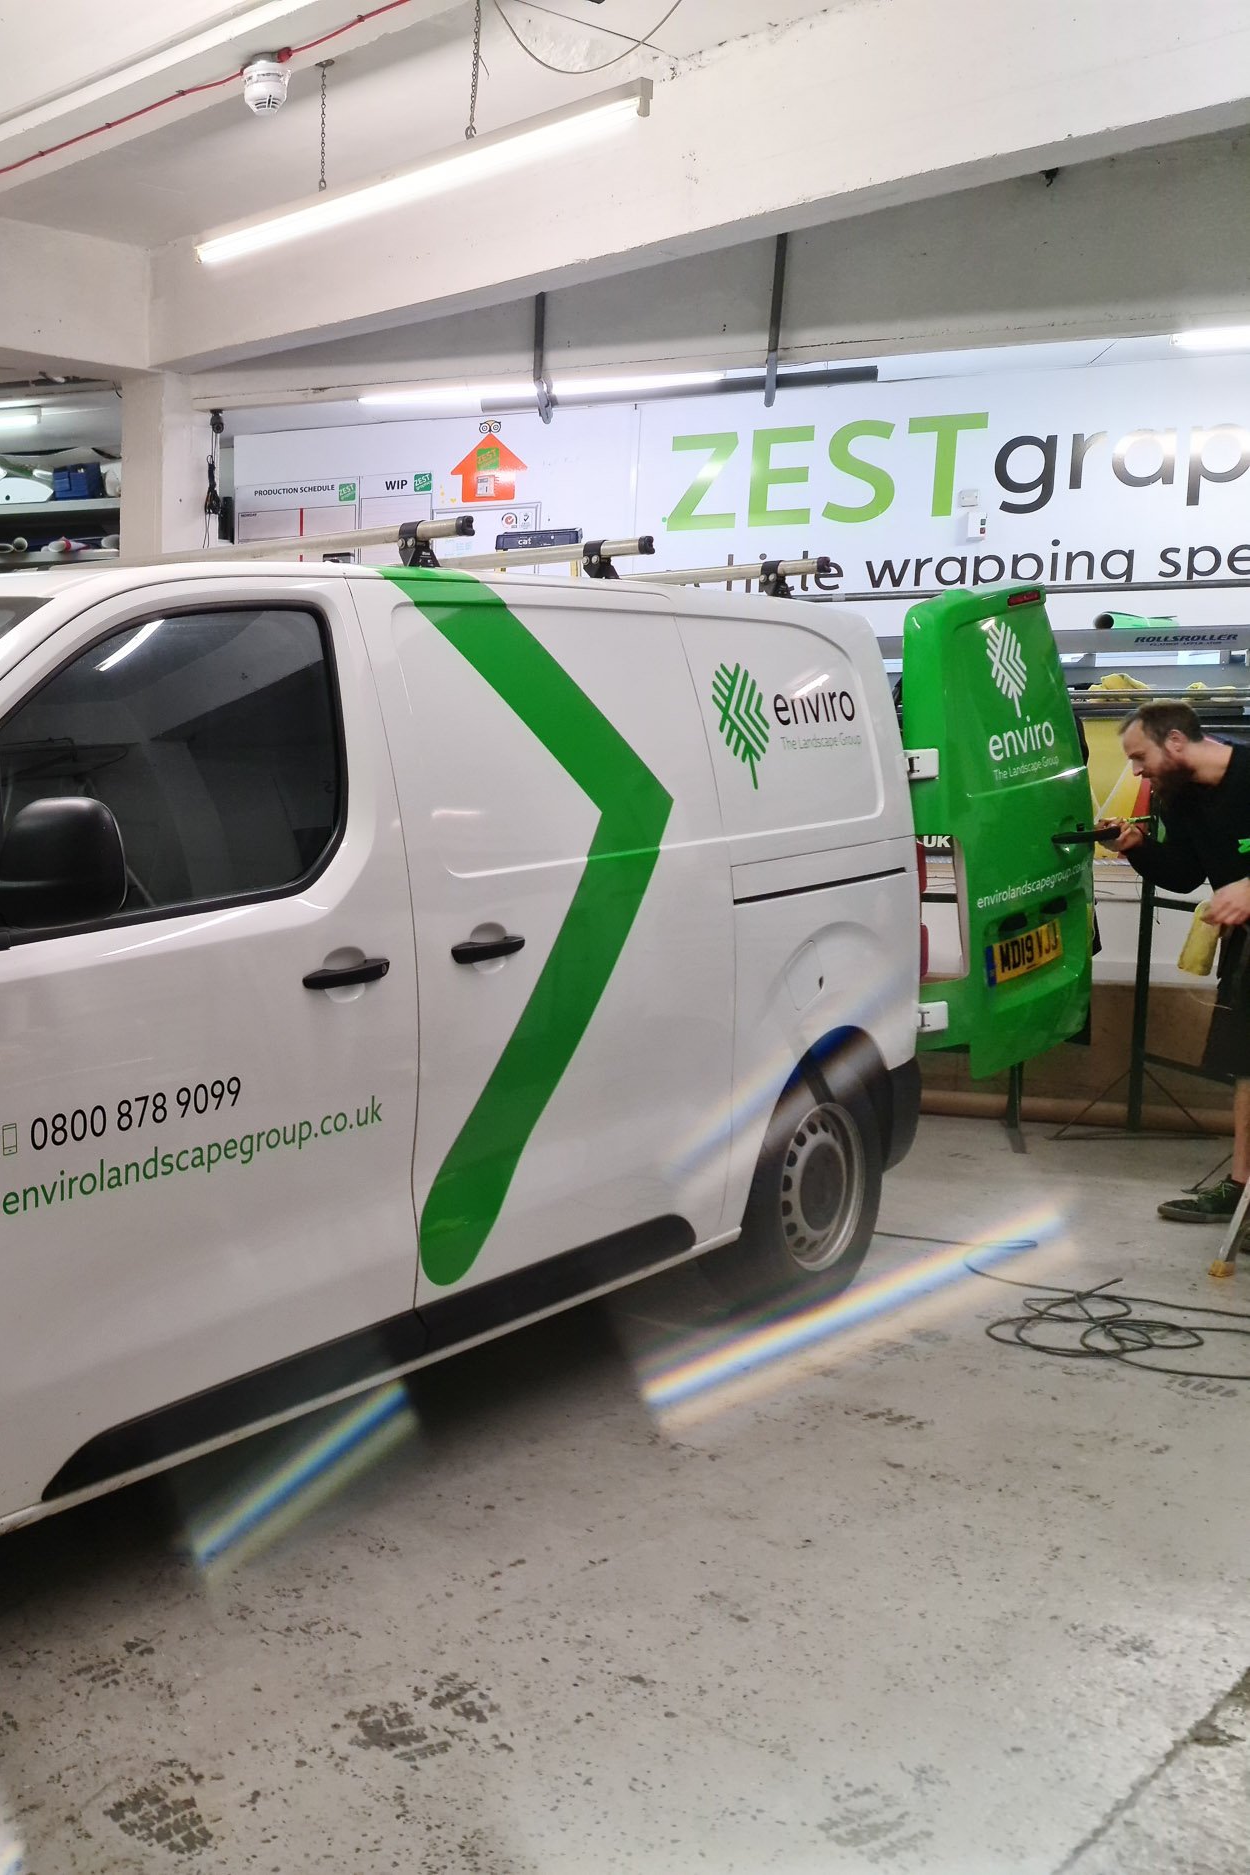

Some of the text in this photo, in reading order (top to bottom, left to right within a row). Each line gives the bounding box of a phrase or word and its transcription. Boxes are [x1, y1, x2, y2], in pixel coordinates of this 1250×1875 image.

[414, 474, 430, 487] ZEST
[666, 411, 990, 532] ZEST
[254, 484, 335, 496] PRODUCTION SCHEDULE
[338, 483, 354, 497] ZEST
[385, 479, 408, 491] WIP
[865, 539, 1136, 588] wrapping
[1134, 633, 1238, 643] ROLLSROLLER
[773, 690, 856, 726] enviro
[780, 732, 862, 751] The Landscape Group
[988, 714, 1055, 761] enviro
[993, 755, 1060, 781] The Landscape Group
[923, 835, 951, 848] UK
[998, 921, 1059, 974] MD19 VJJ
[30, 1076, 241, 1150] 0800 878 9099
[2, 1095, 383, 1215] envirolandscapegroup.co.uk
